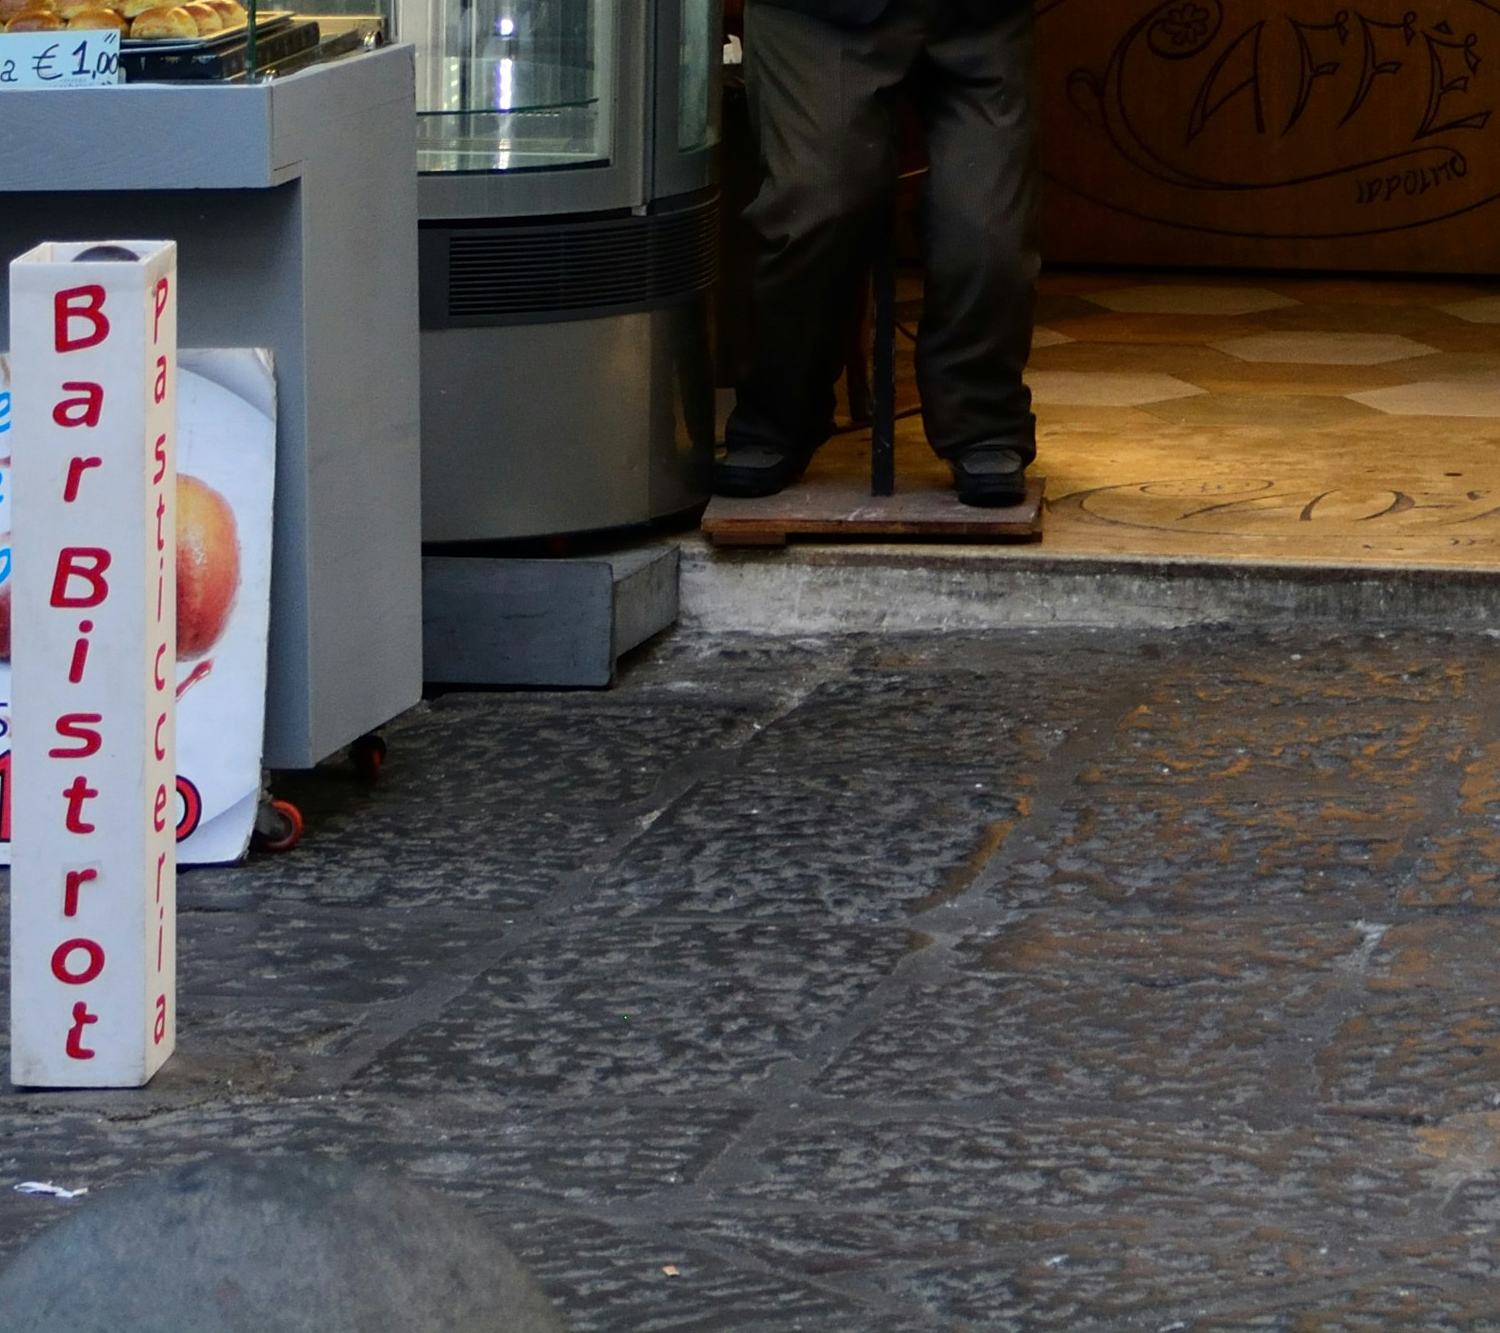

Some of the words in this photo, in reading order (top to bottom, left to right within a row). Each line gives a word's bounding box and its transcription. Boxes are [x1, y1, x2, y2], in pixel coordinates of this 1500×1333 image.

[32, 44, 62, 80] €
[71, 40, 120, 80] 1,00
[51, 285, 110, 504] Bar
[48, 546, 111, 1062] Bistrot
[150, 277, 172, 1049] Pasticceria
